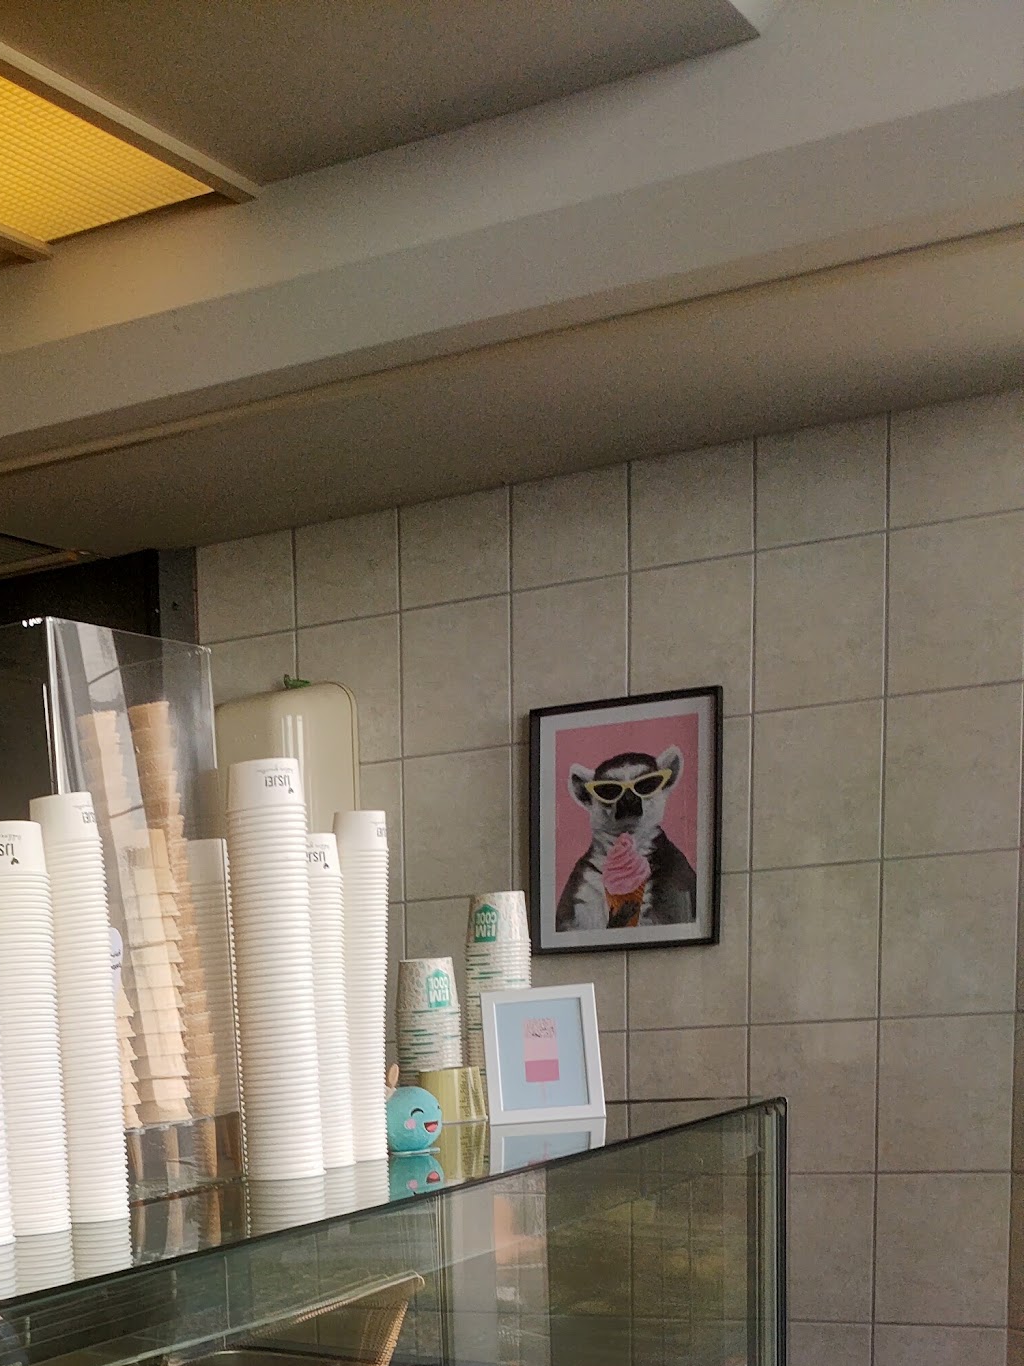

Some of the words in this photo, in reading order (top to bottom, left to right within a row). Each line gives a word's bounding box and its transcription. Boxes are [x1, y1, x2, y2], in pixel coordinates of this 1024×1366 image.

[305, 851, 326, 864] IJSJ
[476, 911, 497, 924] COOL
[427, 976, 449, 989] COOL
